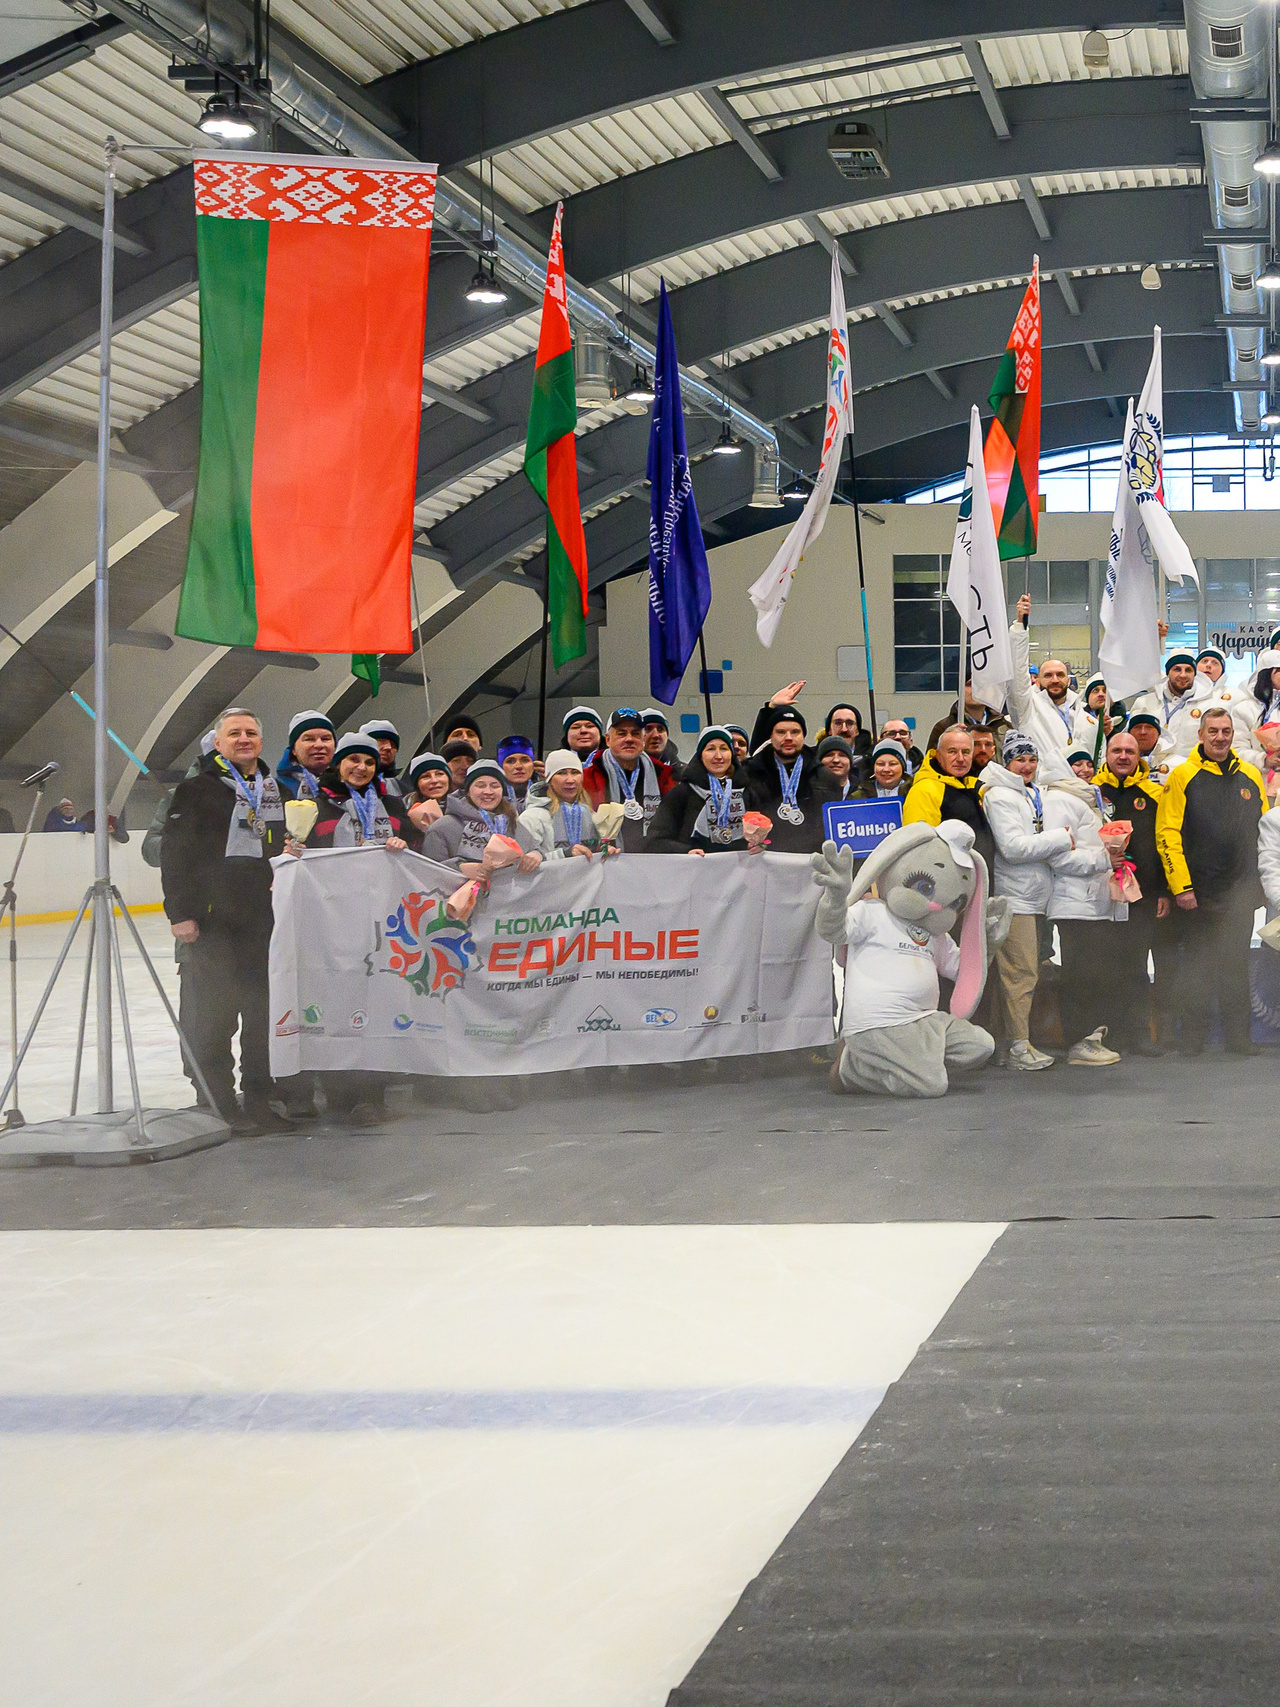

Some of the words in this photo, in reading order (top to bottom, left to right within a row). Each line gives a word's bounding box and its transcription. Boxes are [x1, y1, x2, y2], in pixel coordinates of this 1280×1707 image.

[1240, 625, 1274, 634] КАФЕ
[837, 820, 897, 840] Единые
[494, 907, 620, 936] КОМАНДА
[487, 929, 700, 979] ЕДИНЫЕ
[486, 981, 522, 993] КОГДА
[524, 979, 544, 990] МЫ
[546, 973, 580, 988] ЕДИНЫ
[595, 970, 615, 980] МЫ
[618, 967, 700, 981] НЕПОБЕДИМЫ!
